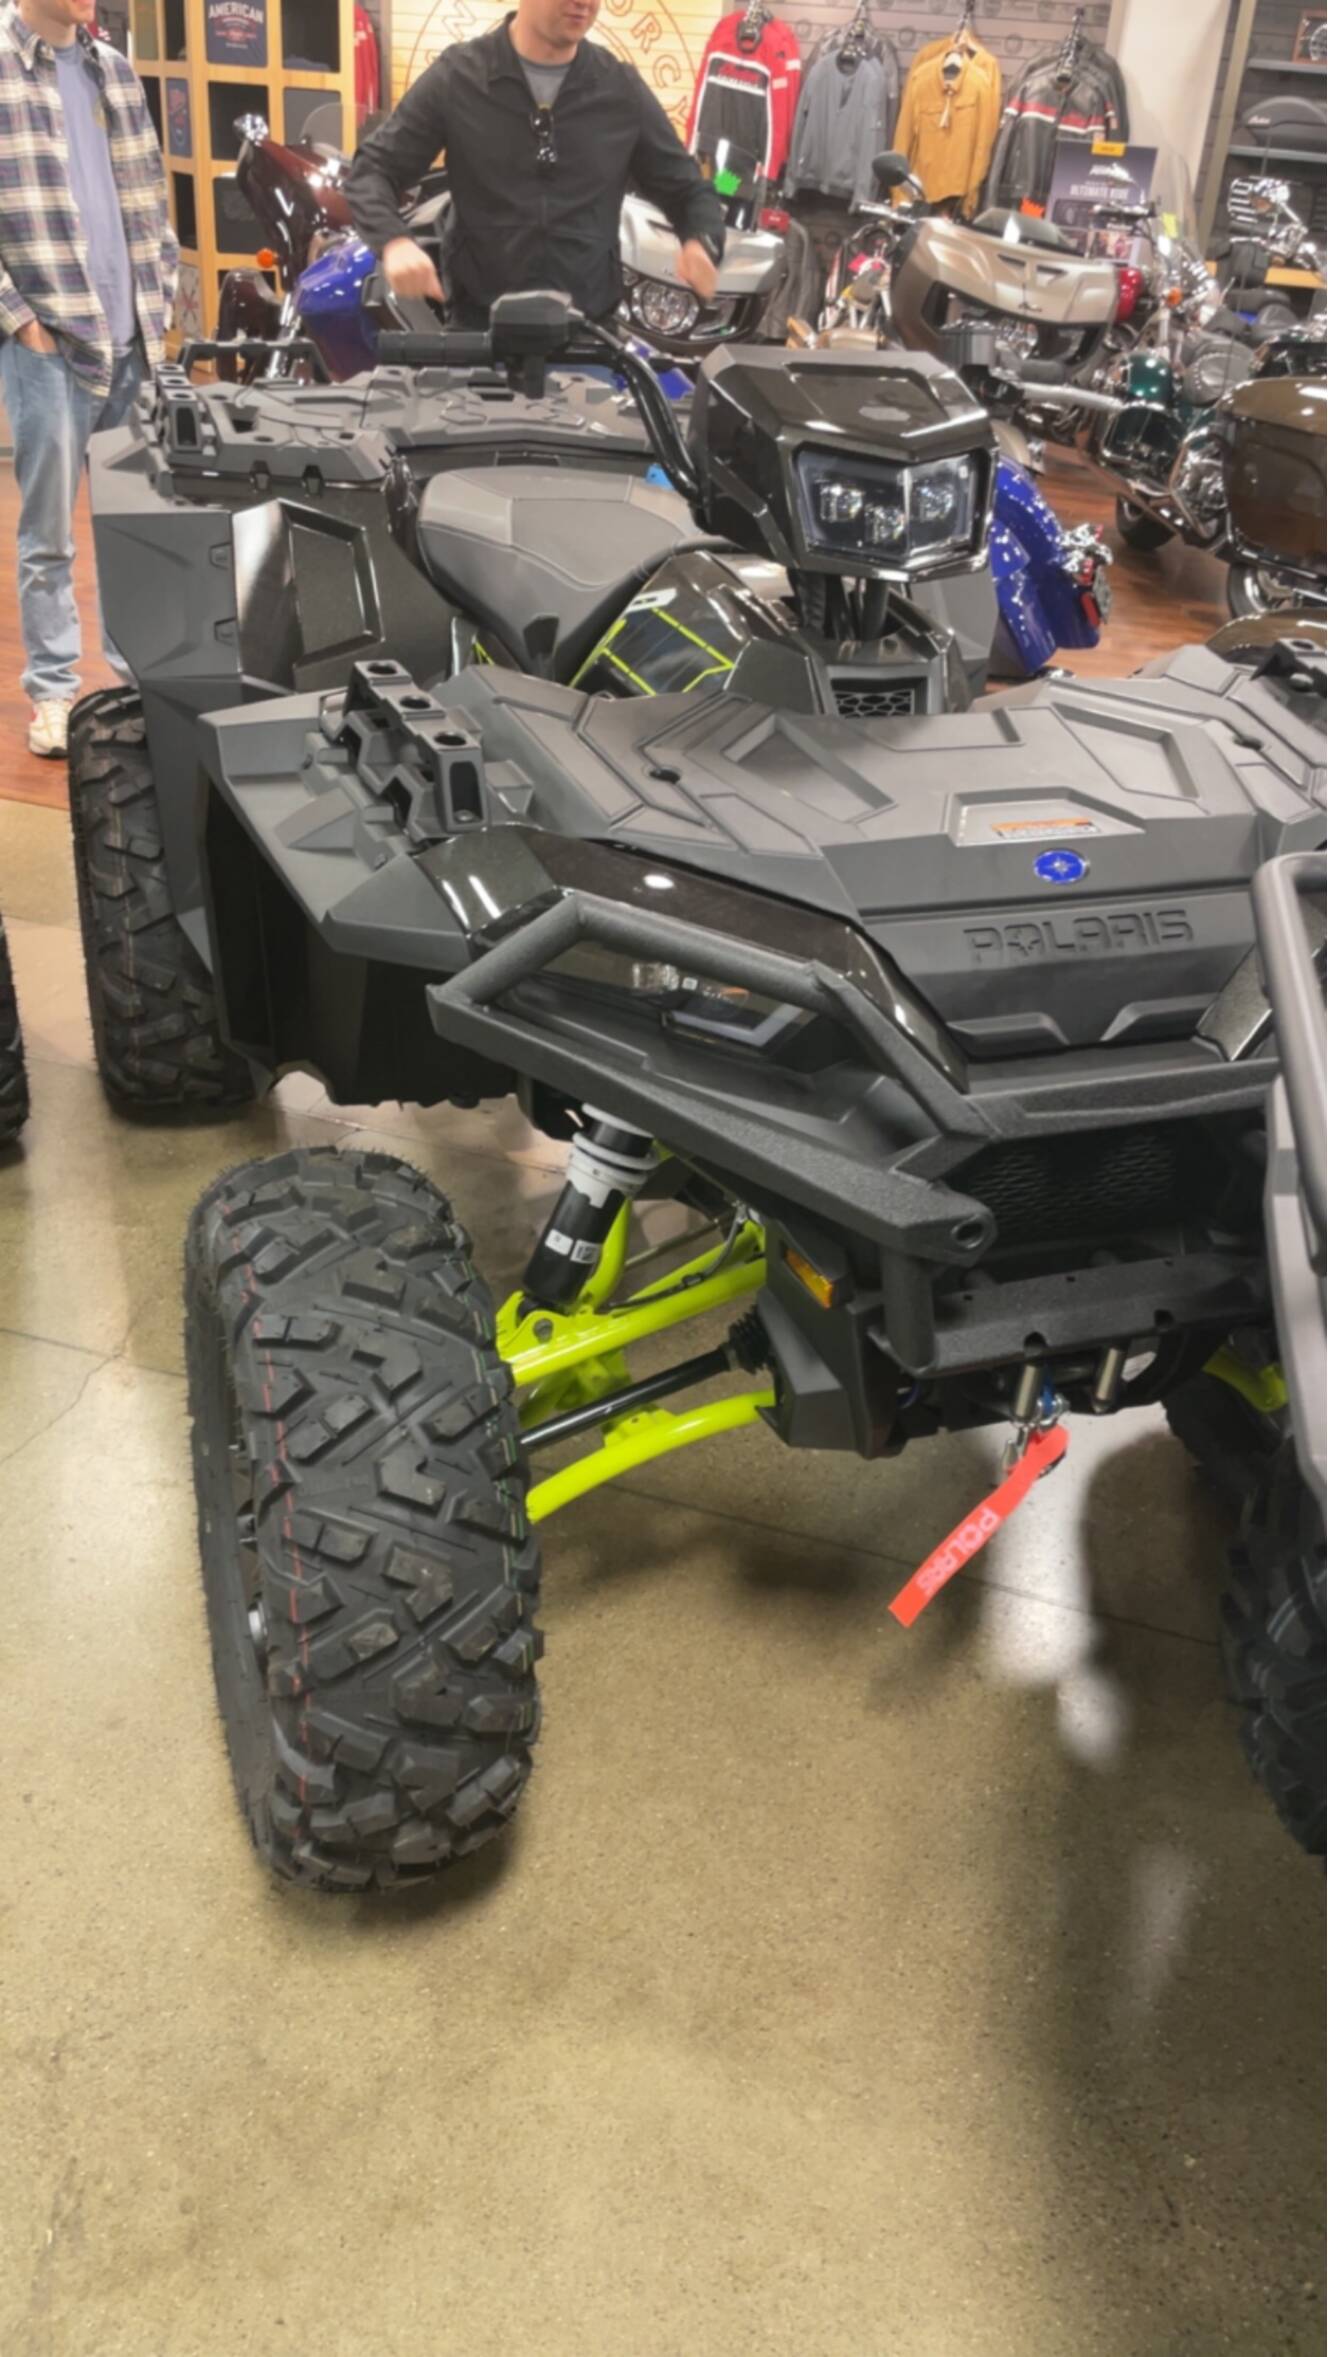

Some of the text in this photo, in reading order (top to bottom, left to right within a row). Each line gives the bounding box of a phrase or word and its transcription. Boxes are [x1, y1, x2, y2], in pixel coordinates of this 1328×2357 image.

[208, 1, 264, 24] AMERICAN
[963, 909, 1194, 963] POLARIS
[916, 1506, 998, 1596] POLARIS
